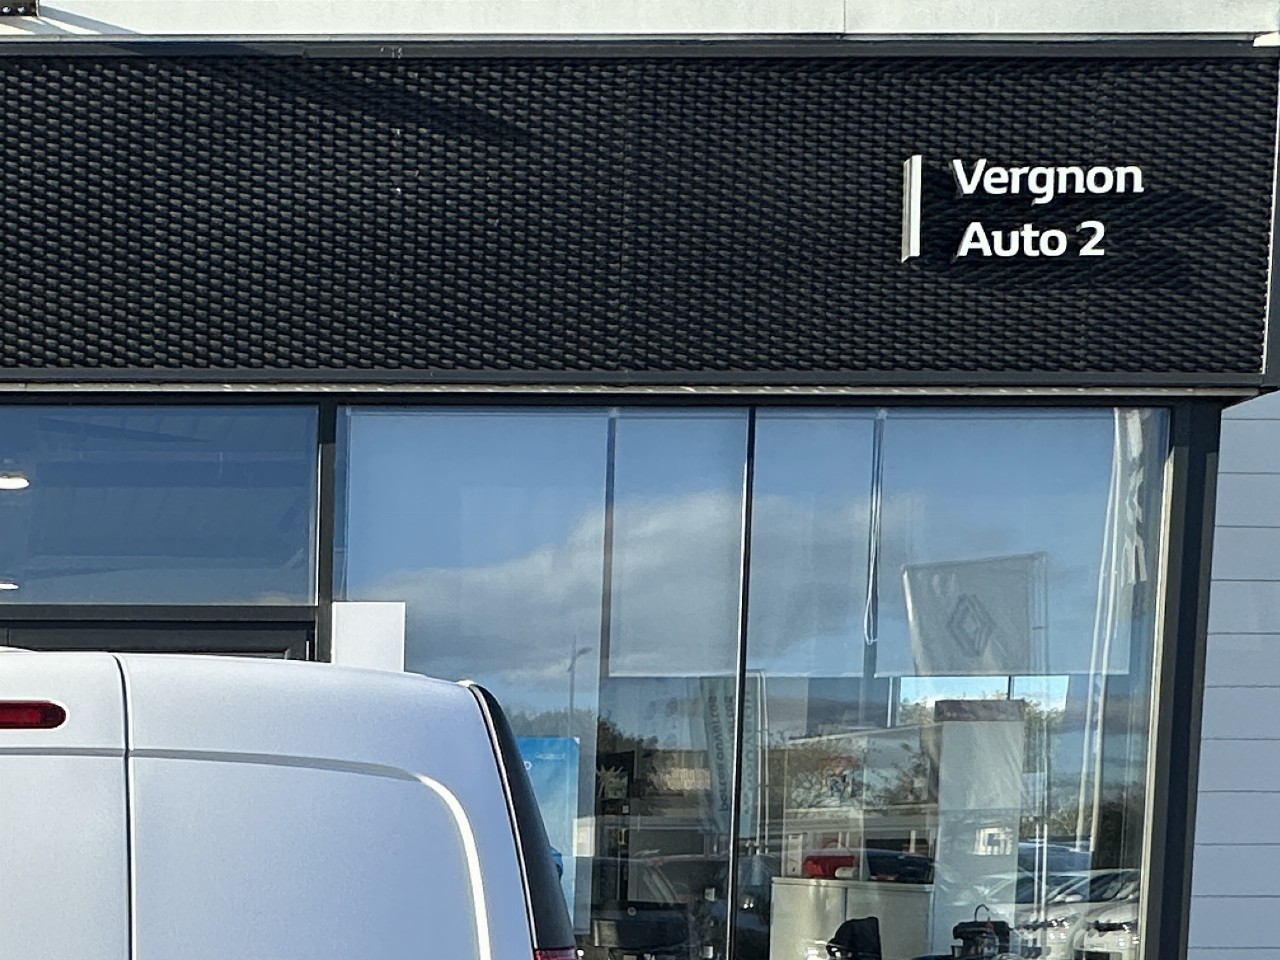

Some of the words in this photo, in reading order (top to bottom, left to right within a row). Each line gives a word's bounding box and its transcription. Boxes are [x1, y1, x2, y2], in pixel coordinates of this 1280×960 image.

[951, 158, 1145, 206] Vergnon
[956, 221, 1068, 257] Auto
[1076, 220, 1106, 257] 2
